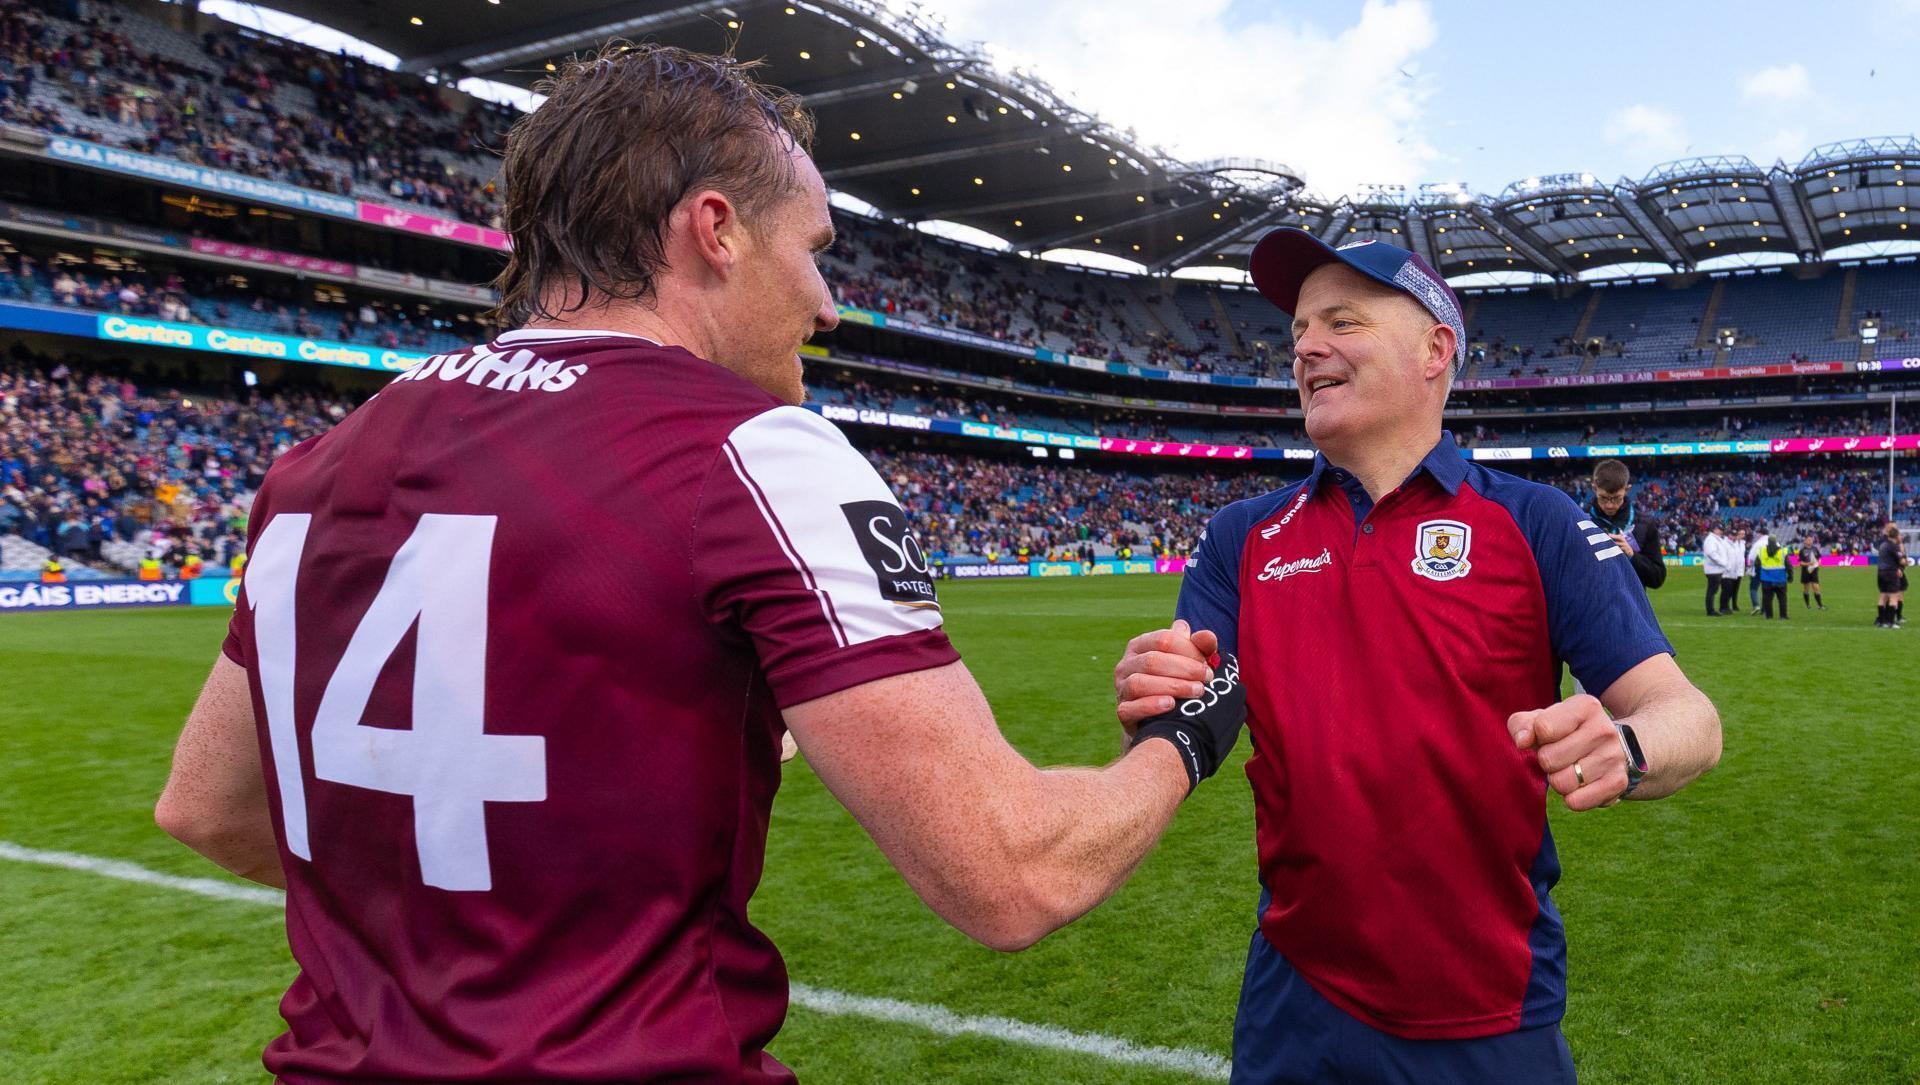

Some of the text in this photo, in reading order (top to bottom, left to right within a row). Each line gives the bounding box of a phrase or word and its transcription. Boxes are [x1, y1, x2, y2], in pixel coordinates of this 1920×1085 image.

[104, 317, 193, 346] Centra
[207, 329, 287, 357] Centra
[298, 341, 371, 366] Centra
[822, 405, 858, 422] BORD
[889, 413, 932, 430] ENERGY
[1284, 449, 1314, 459] BORD
[955, 565, 979, 576] BORD
[1039, 562, 1072, 576] Centra
[74, 584, 185, 605] ENERGY
[244, 513, 547, 891] 14
